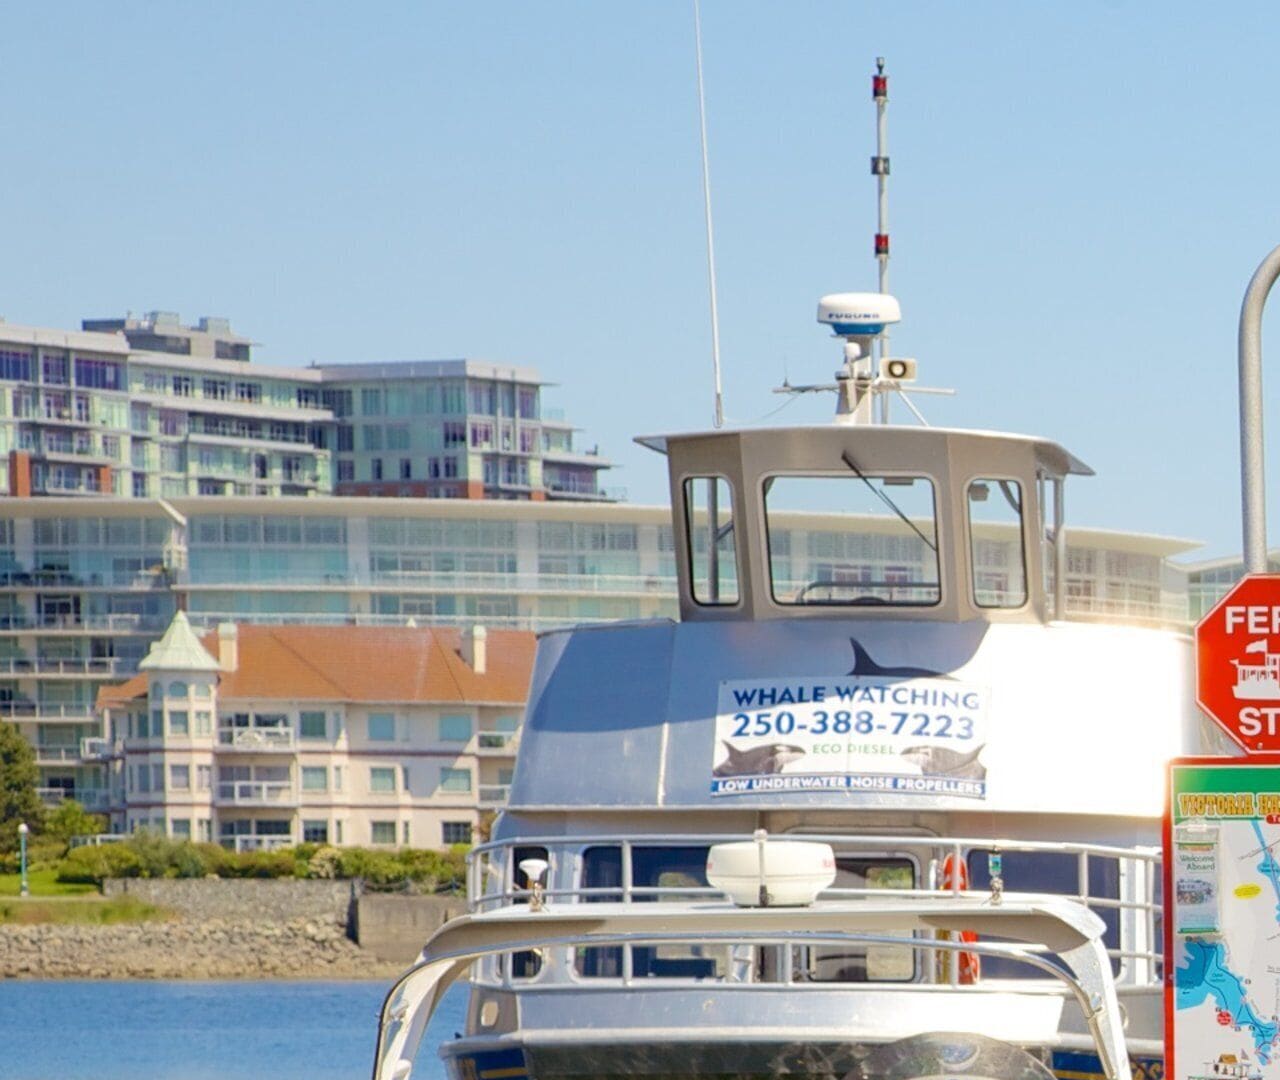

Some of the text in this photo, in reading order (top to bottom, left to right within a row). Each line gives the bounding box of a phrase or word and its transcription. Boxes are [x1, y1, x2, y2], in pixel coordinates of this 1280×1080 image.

[733, 685, 980, 710] WHALE WATCHING
[731, 711, 975, 740] 250-388-7223
[812, 744, 897, 755] ECO DIESEL
[718, 775, 983, 795] LOW UNDERWATER NOISE PROPELLERS
[1178, 793, 1255, 816] VICTORIA
[1180, 855, 1215, 863] Welcome
[1186, 862, 1216, 870] Aboard
